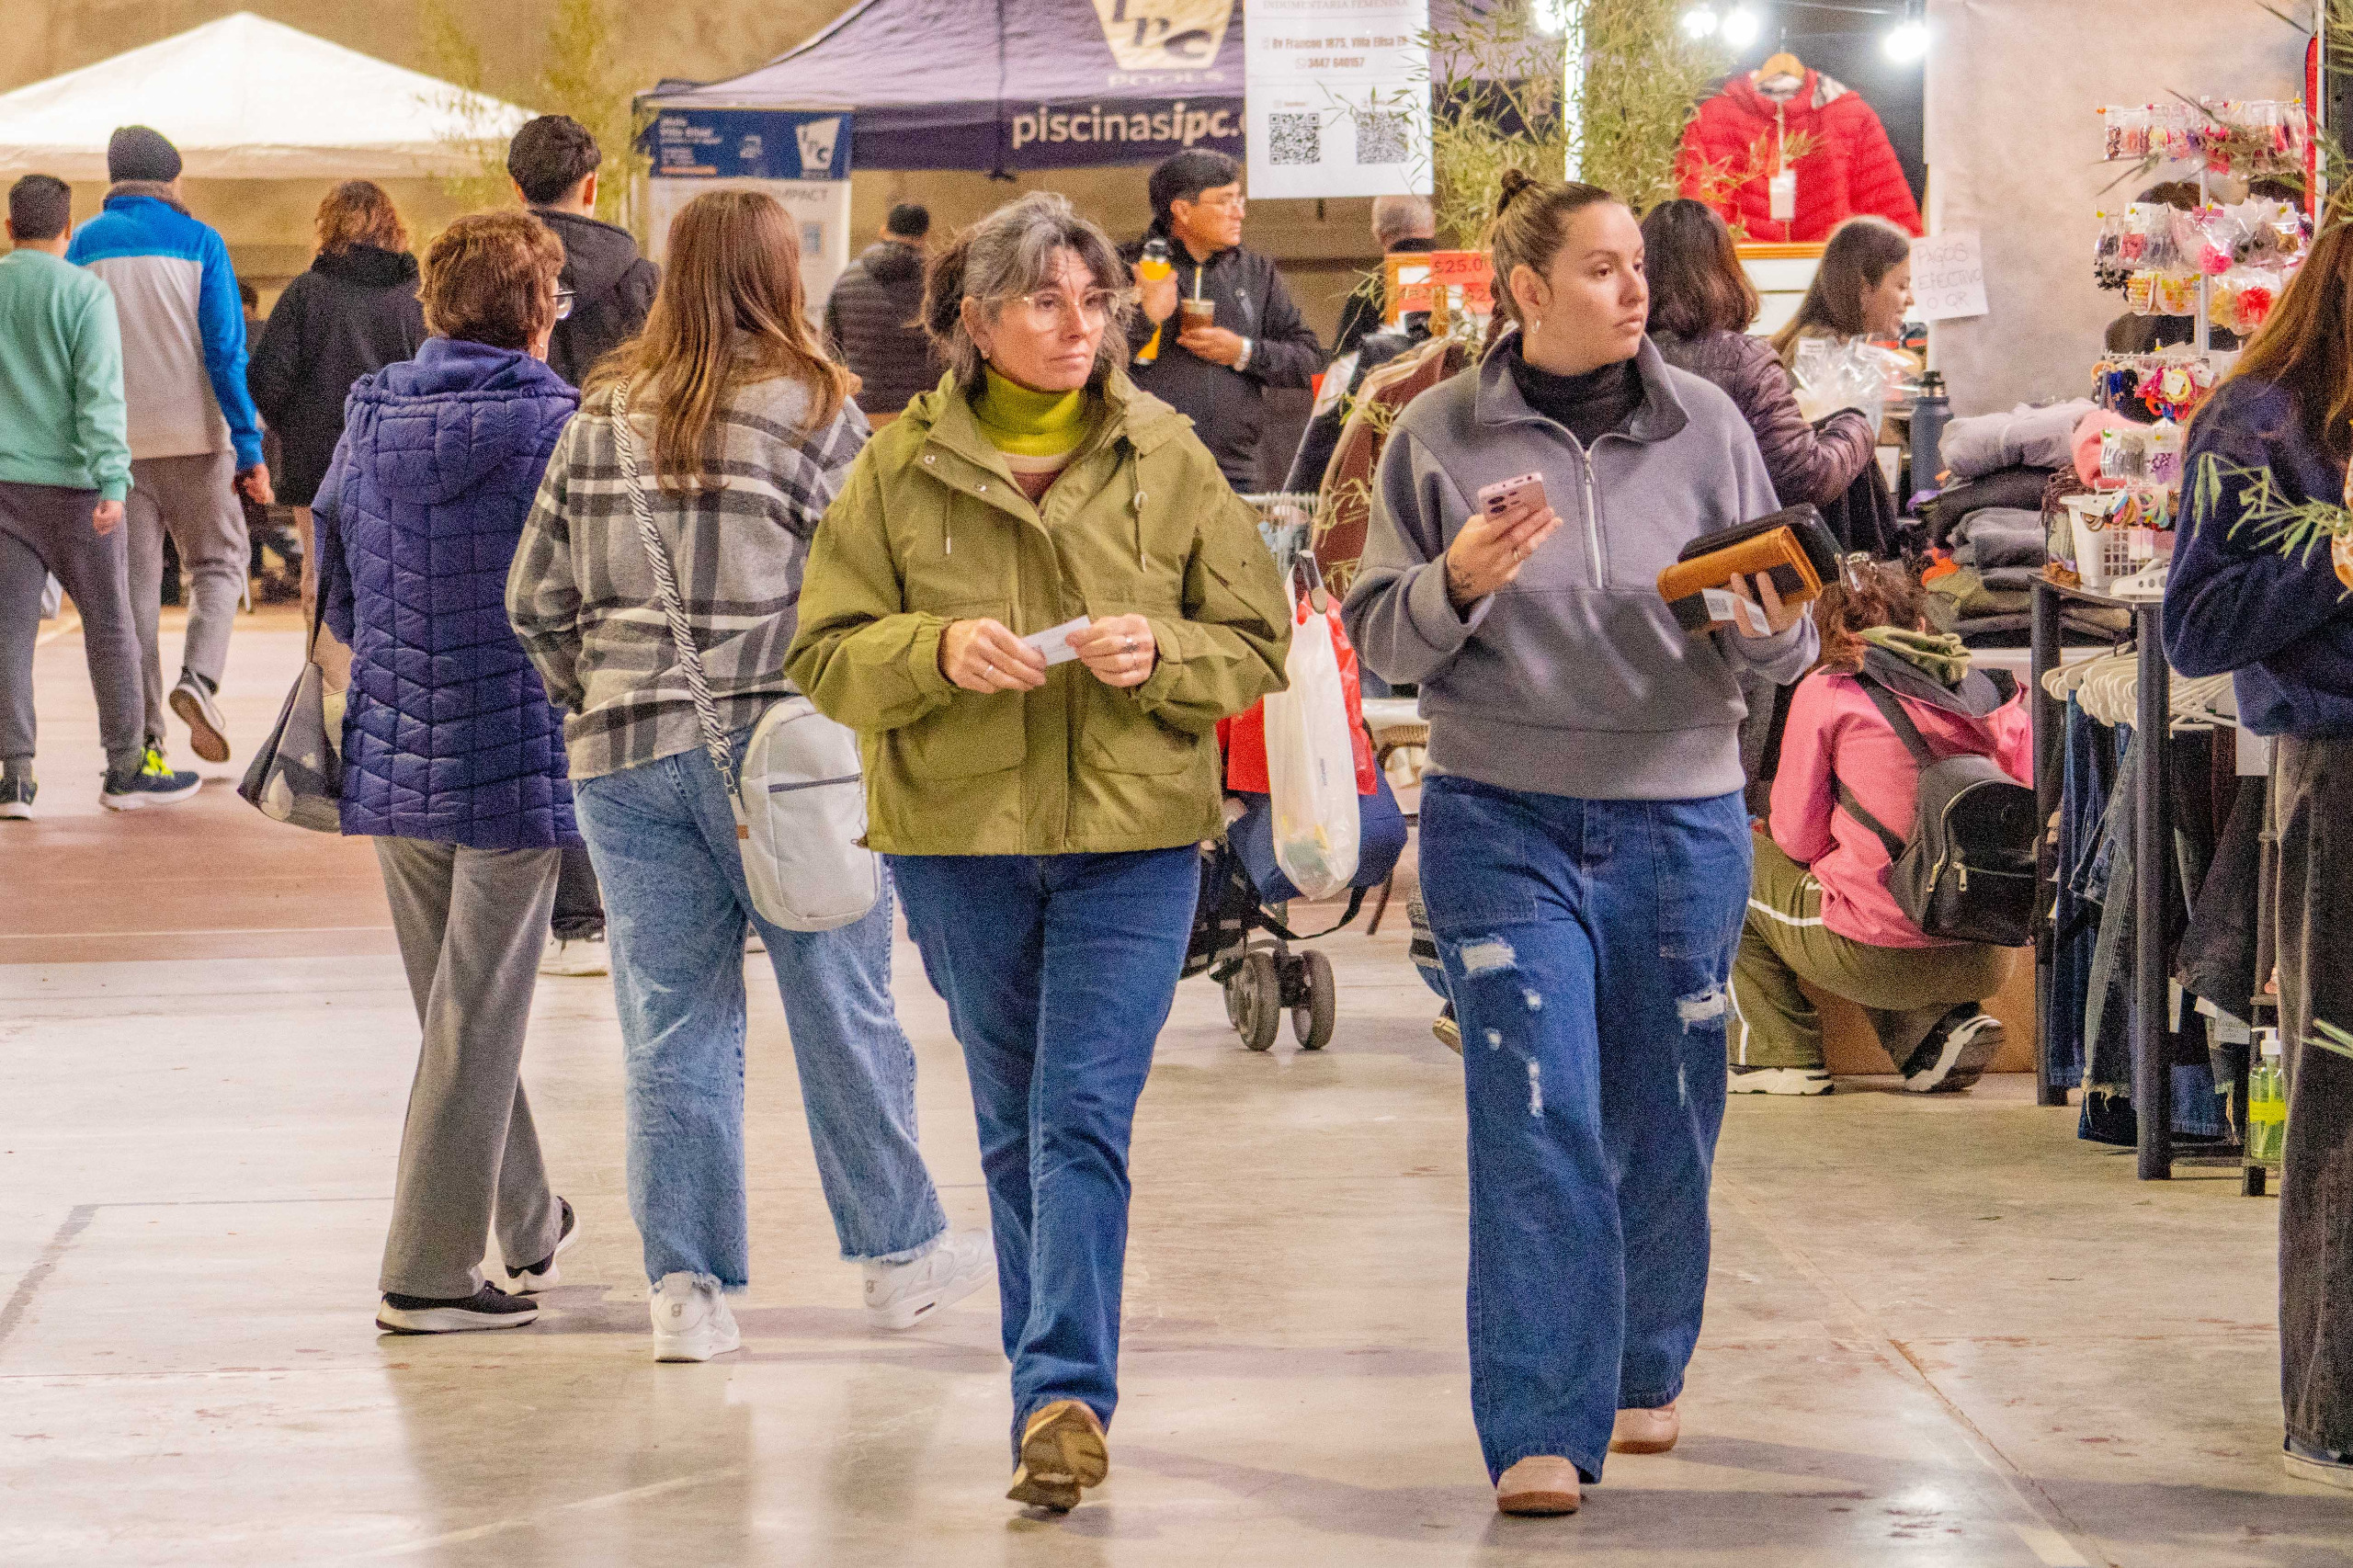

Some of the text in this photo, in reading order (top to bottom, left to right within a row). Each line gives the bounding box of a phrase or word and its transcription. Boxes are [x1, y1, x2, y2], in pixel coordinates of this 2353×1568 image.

[1263, 0, 1409, 9] INDUMENTARIA FEMENINA
[1012, 102, 1245, 150] piscinasipc.
[1915, 243, 1969, 267] PAGOS
[1917, 268, 1983, 290] EFECTIVO
[1927, 291, 1971, 311] O QR
